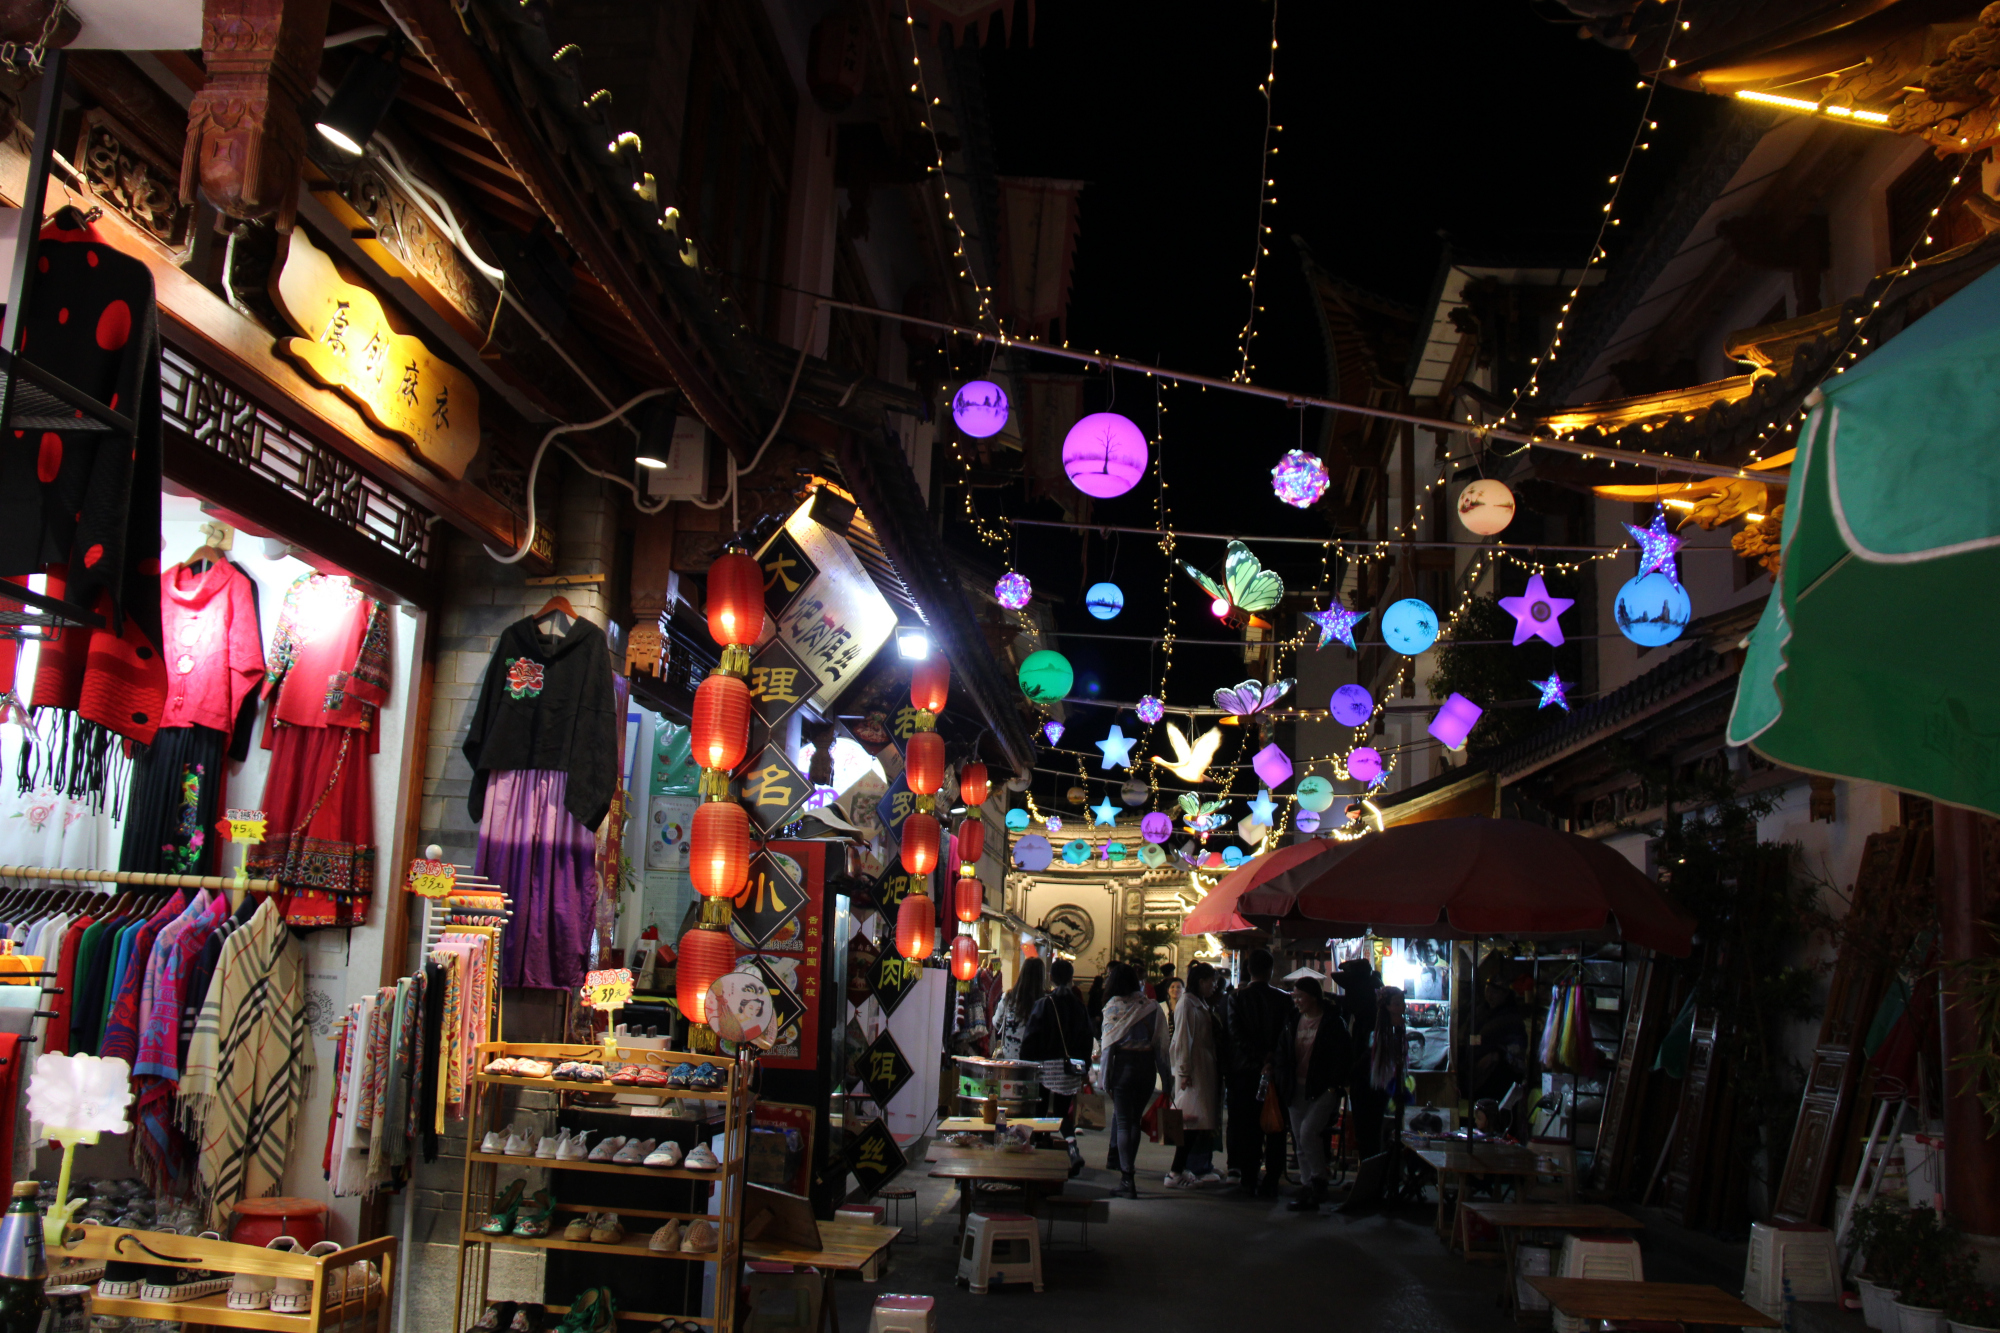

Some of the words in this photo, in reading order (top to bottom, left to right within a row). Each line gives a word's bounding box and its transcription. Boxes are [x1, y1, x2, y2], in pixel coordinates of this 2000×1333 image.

[319, 299, 450, 430] 原创麻衣
[540, 537, 552, 559] 104
[227, 809, 265, 821] 震撼价
